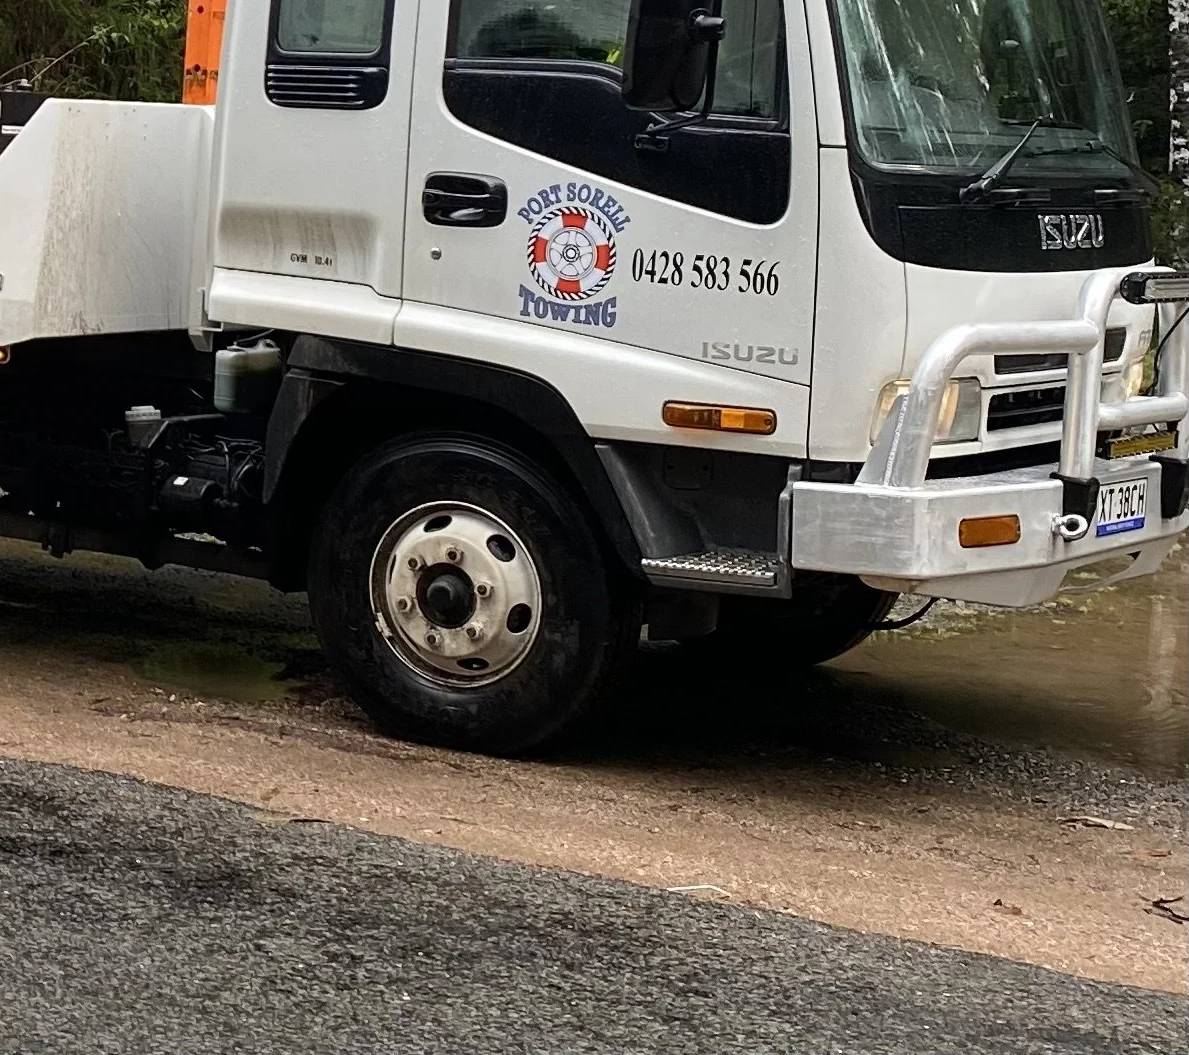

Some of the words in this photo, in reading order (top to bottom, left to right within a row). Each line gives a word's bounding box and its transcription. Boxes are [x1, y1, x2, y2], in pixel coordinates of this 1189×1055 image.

[517, 184, 562, 225] PORT
[566, 182, 631, 234] SORELL
[1037, 214, 1105, 250] ISUZU
[632, 248, 684, 286] 0428
[690, 254, 731, 291] 583
[738, 259, 781, 296] 566
[518, 283, 617, 328] TOWING
[701, 341, 799, 365] ISUZU
[1098, 488, 1115, 523] XT
[1116, 482, 1146, 520] 38CH
